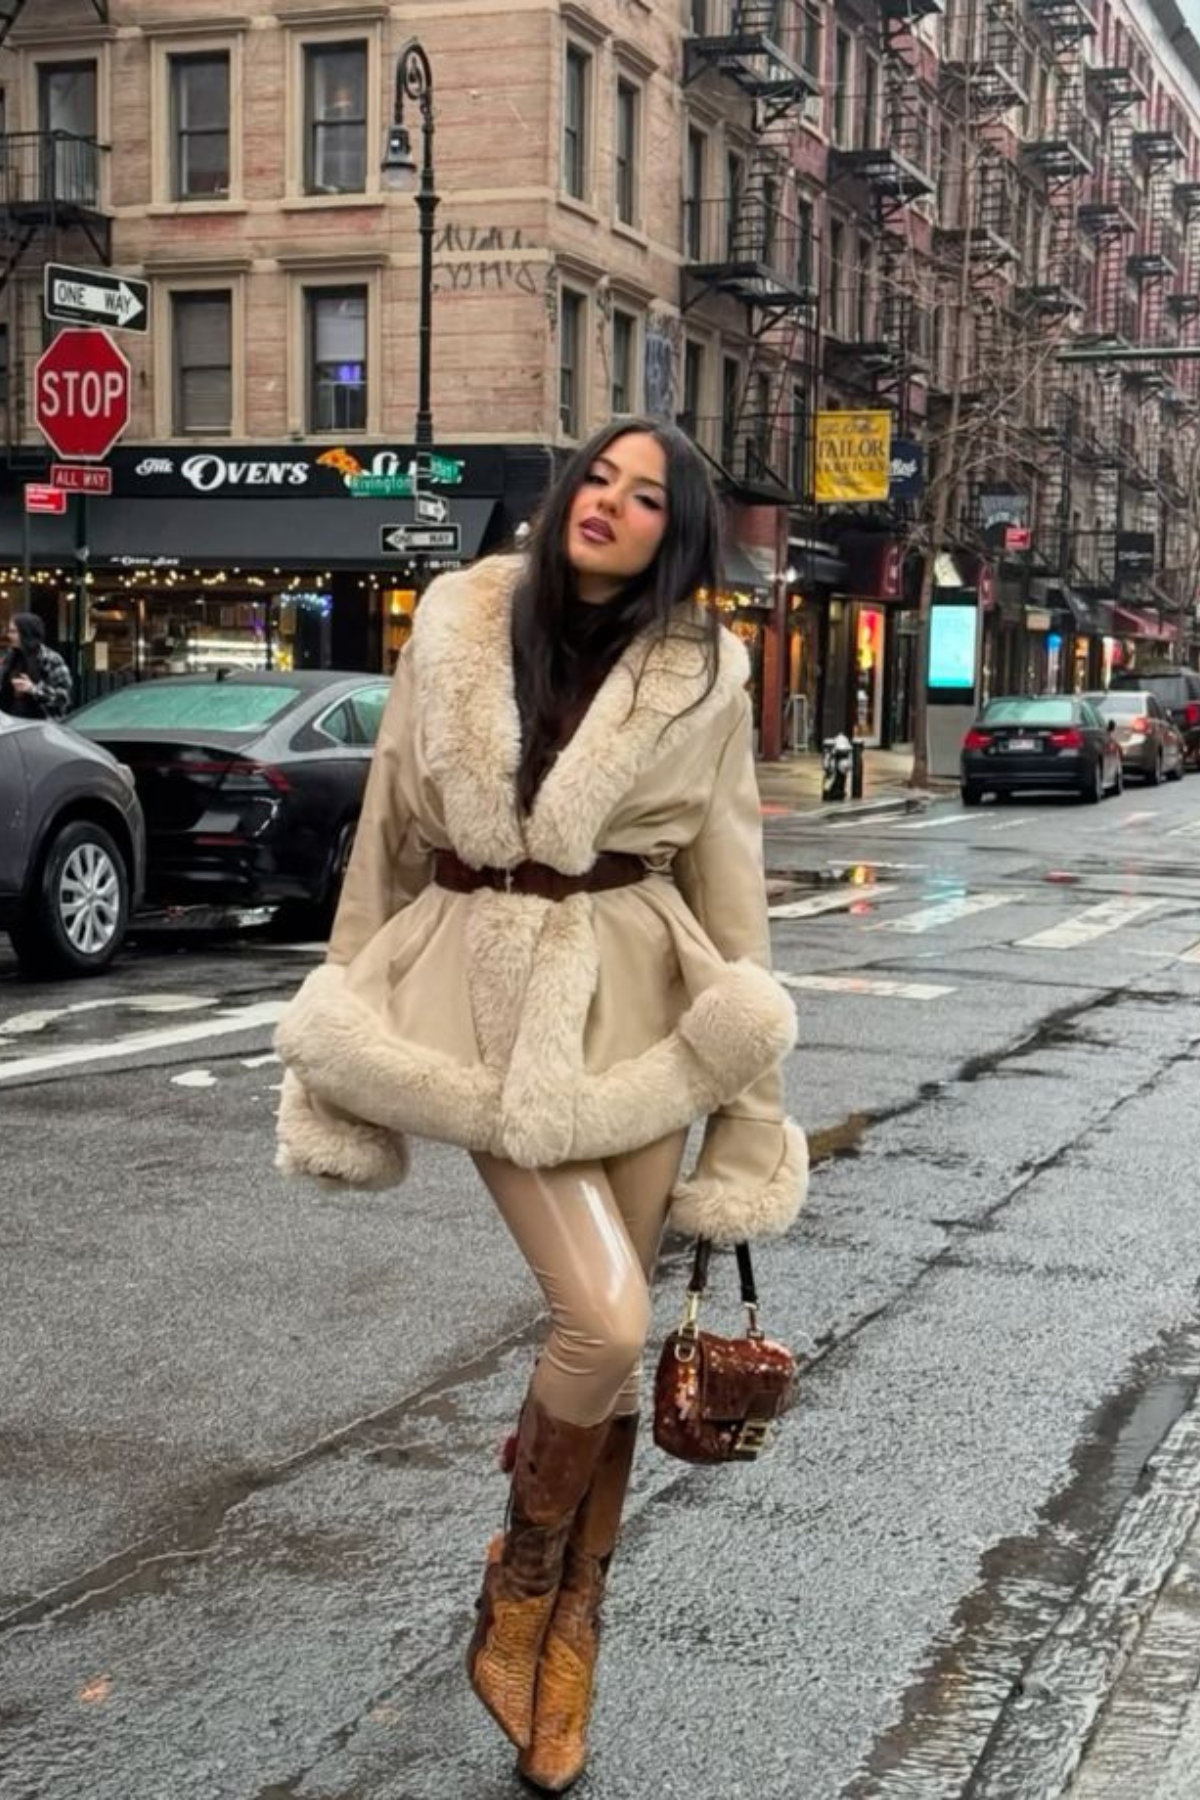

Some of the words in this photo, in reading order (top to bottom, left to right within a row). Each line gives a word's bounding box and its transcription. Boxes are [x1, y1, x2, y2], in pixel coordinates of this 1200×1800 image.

[57, 283, 86, 306] ONE
[104, 292, 133, 314] WAY
[41, 370, 124, 418] STOP
[819, 439, 885, 458] TAILOR
[56, 470, 79, 486] ALL
[83, 472, 106, 487] WAY
[394, 534, 412, 545] ONE
[429, 534, 450, 544] WAY
